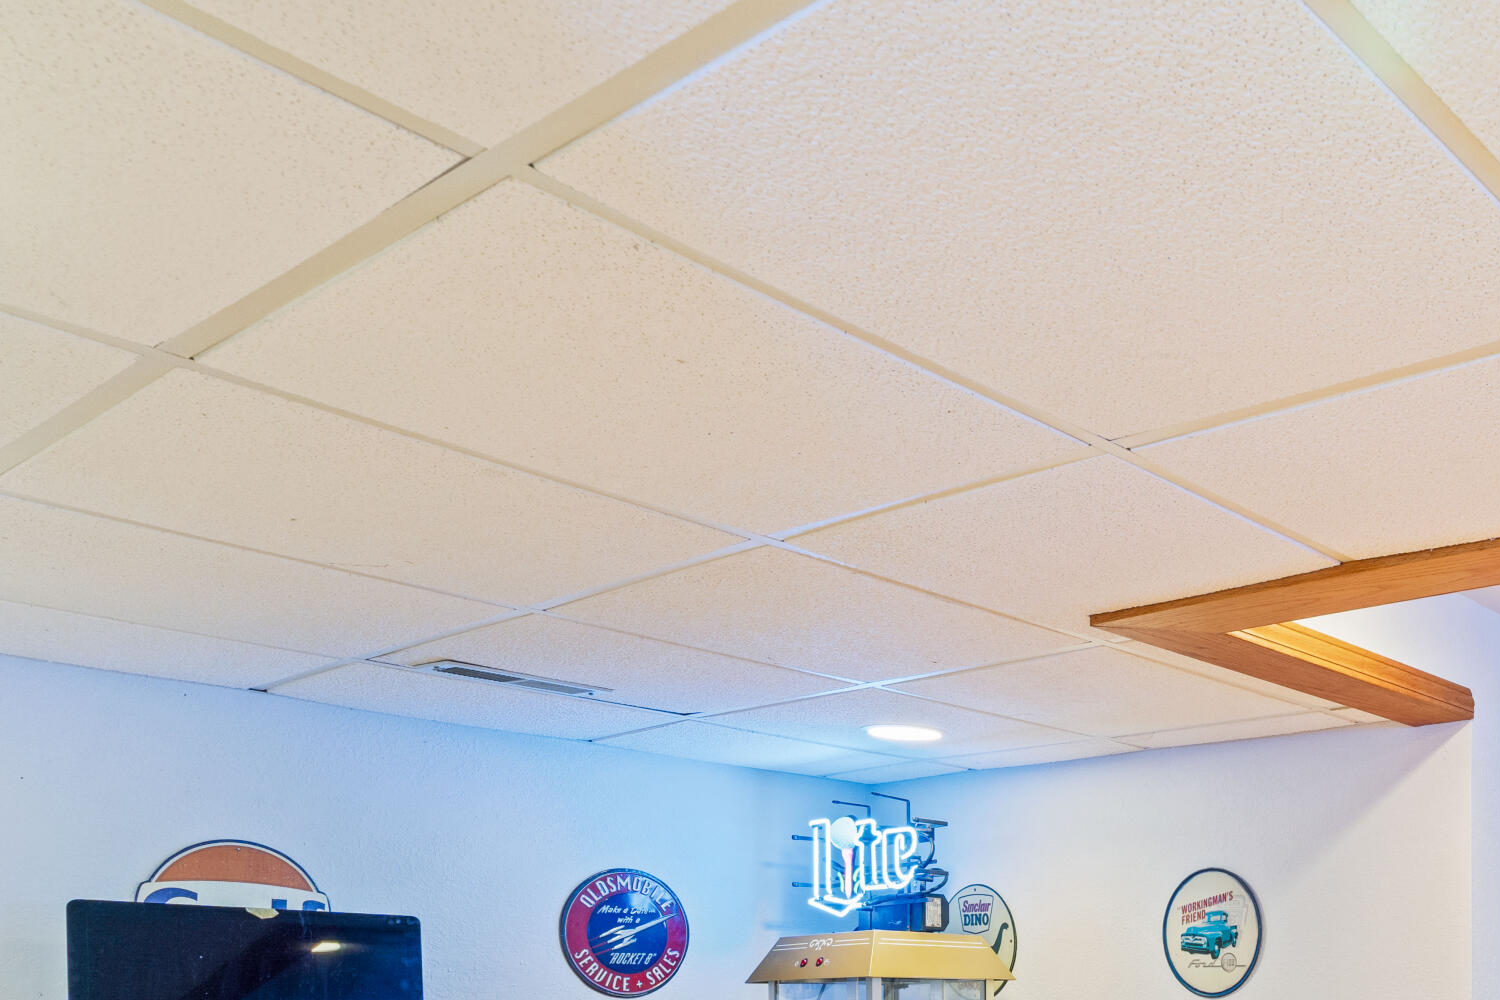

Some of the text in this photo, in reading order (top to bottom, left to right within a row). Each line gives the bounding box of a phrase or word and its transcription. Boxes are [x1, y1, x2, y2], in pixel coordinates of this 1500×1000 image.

[580, 874, 675, 912] OLDSMOBILE
[597, 904, 621, 914] Make
[962, 899, 991, 913] Sinclair
[616, 915, 634, 924] with
[963, 912, 990, 926] DINO
[1181, 909, 1206, 926] FRIEND
[574, 948, 631, 992] SERVICE
[645, 947, 681, 986] SALES
